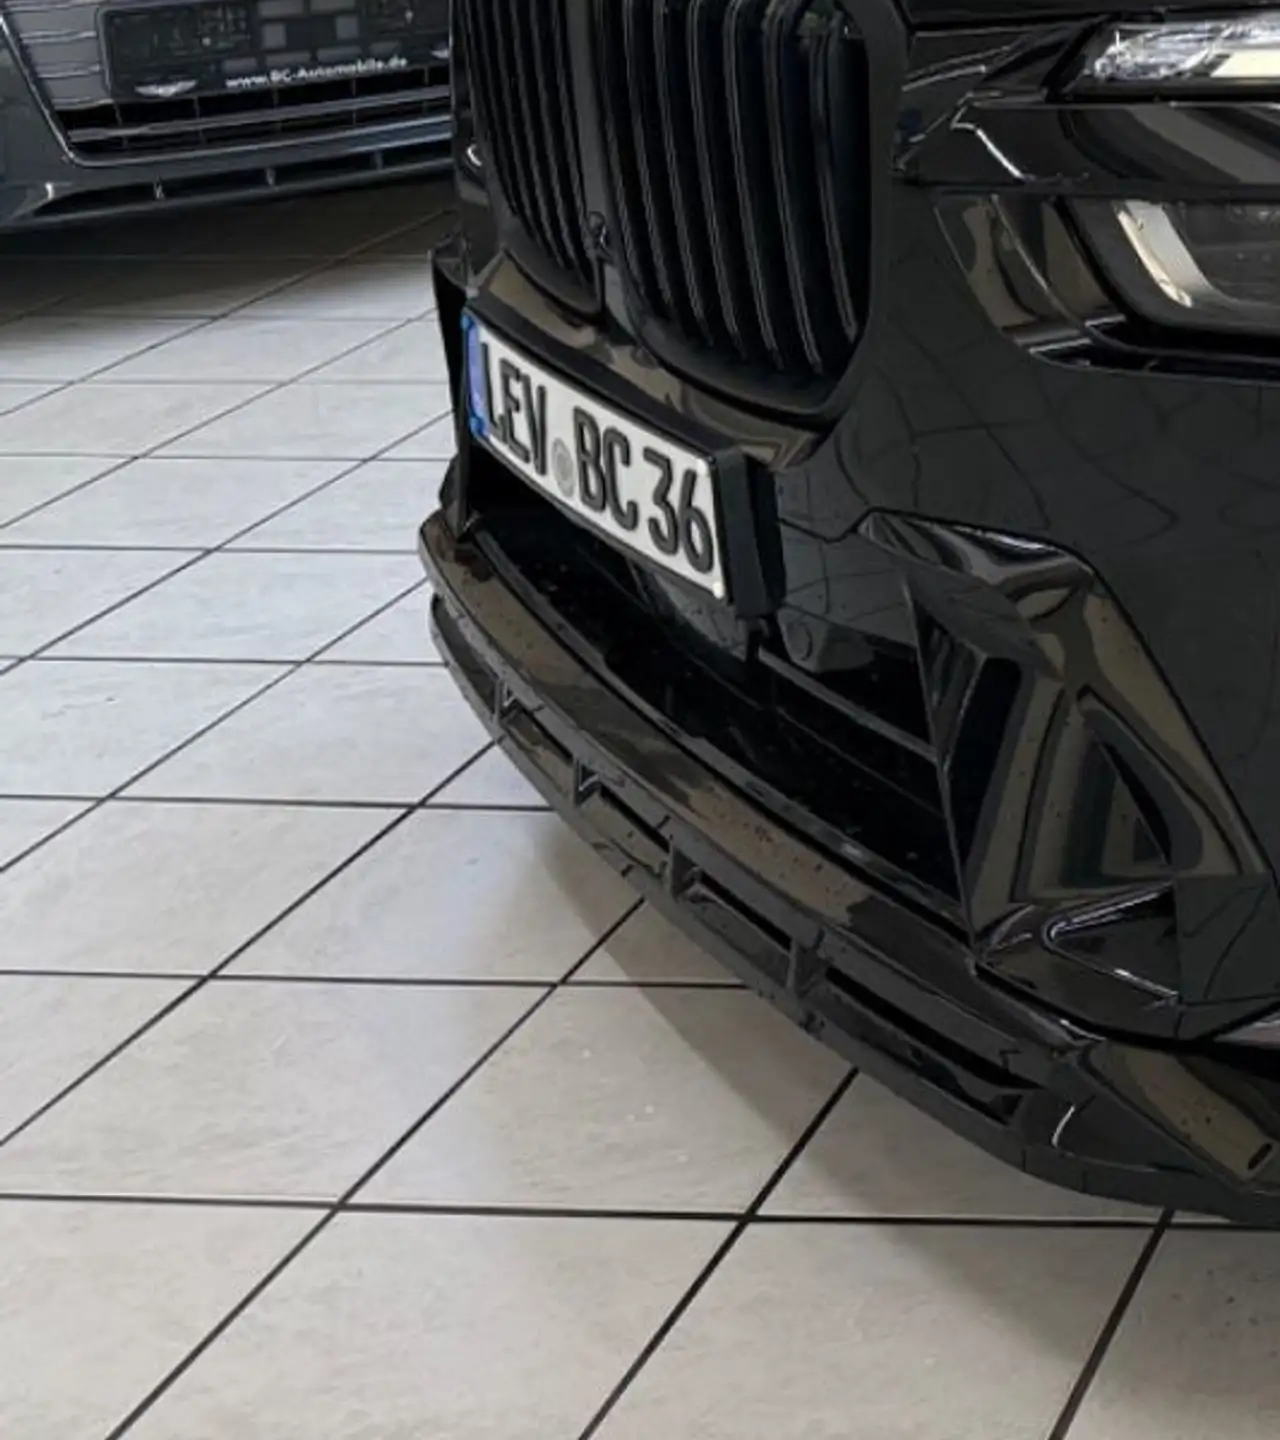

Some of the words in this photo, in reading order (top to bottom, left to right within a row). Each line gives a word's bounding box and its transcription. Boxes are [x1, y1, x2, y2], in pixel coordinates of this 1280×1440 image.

[480, 341, 548, 477] LEV
[573, 405, 639, 532] BC
[642, 445, 714, 574] 36
